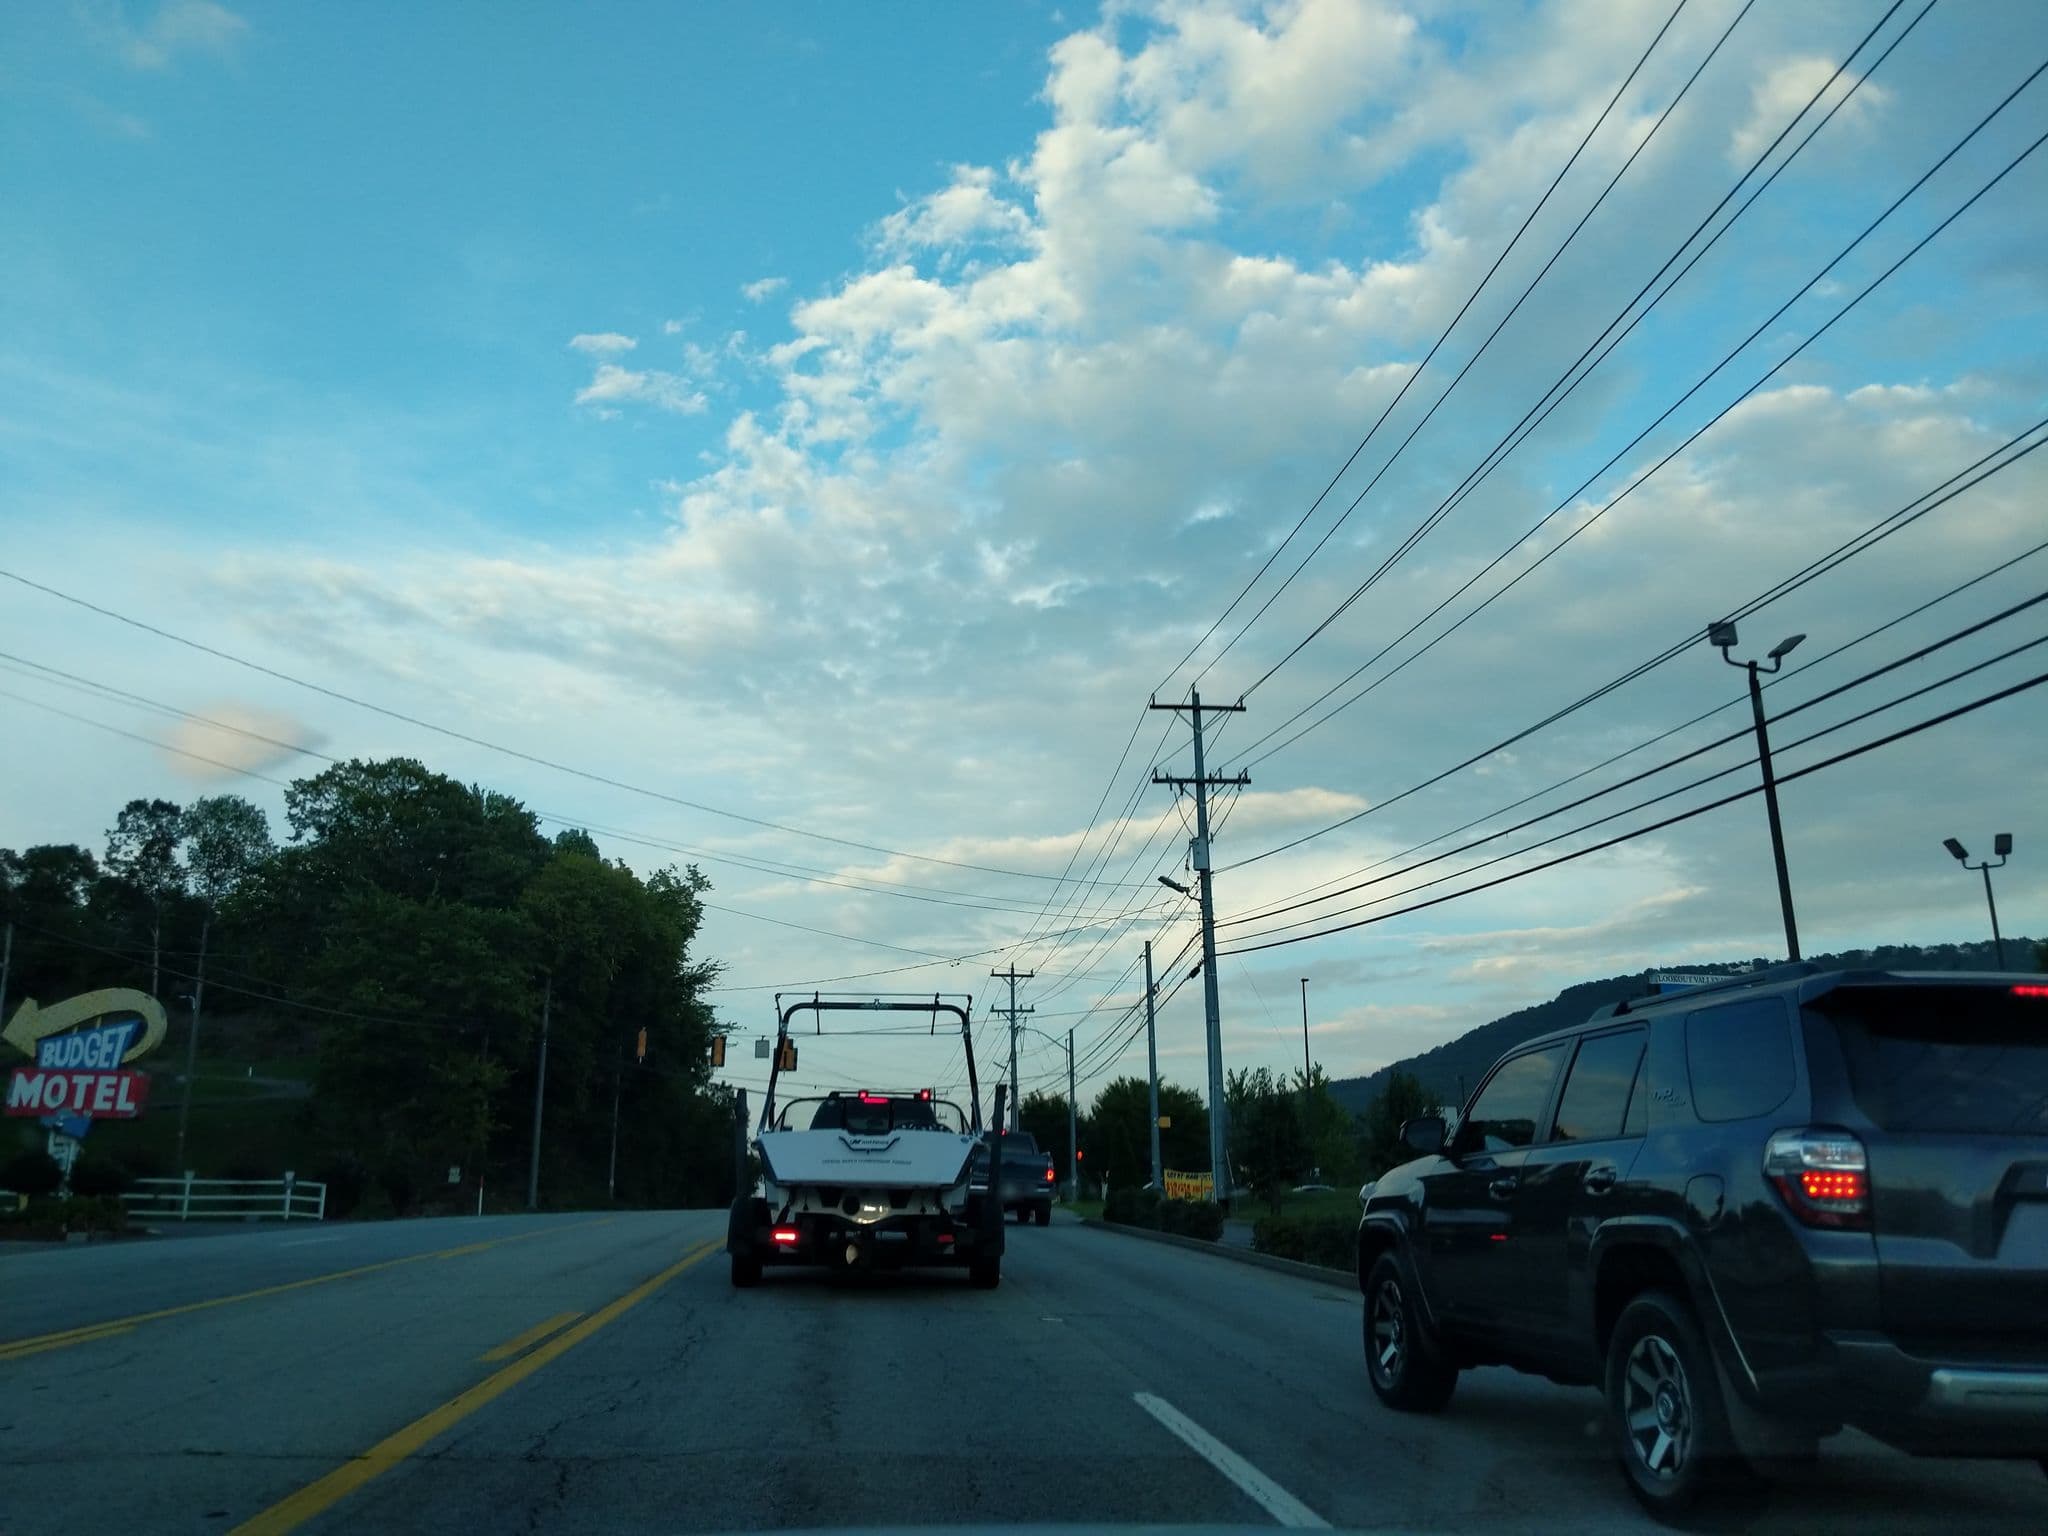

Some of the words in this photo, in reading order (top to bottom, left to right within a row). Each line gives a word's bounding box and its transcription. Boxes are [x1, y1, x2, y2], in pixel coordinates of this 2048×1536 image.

[1658, 974, 1692, 984] LOOKOUT
[39, 1024, 134, 1069] BUDGET
[8, 1072, 136, 1112] MOTEL
